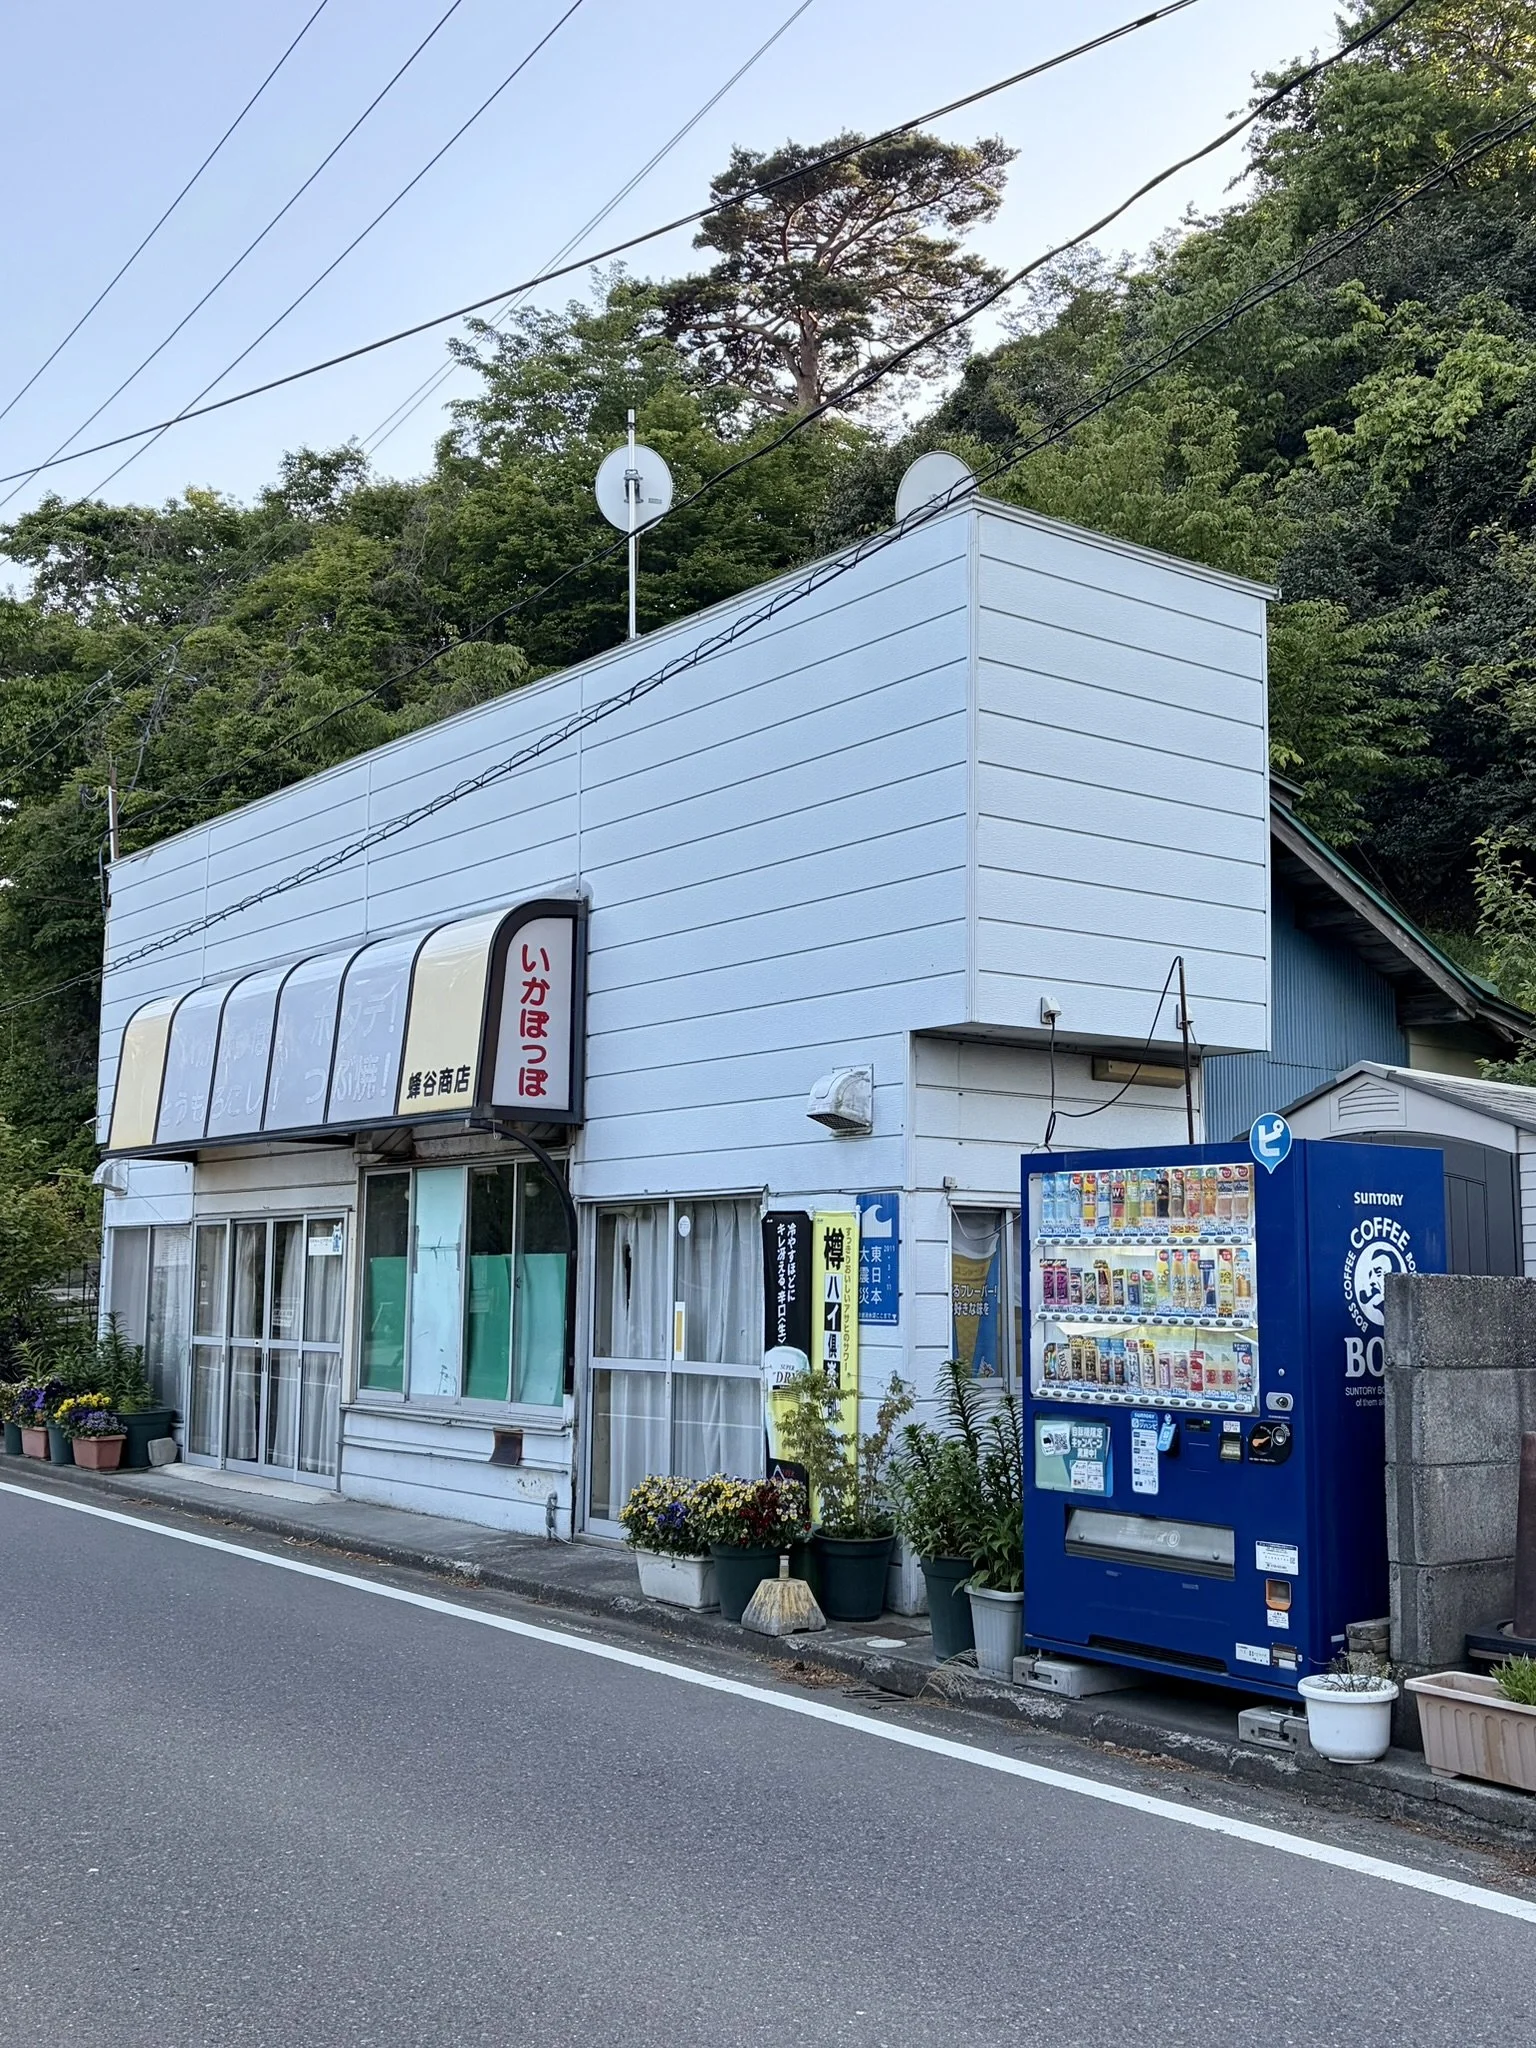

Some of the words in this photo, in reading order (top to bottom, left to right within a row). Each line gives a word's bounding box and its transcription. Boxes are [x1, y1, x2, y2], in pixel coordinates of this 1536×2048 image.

[519, 943, 551, 1097] いかぽっぽ
[406, 1064, 471, 1100] 蜂谷商店
[1353, 1191, 1404, 1207] SUNTORY
[1350, 1216, 1411, 1252] COFFEE
[870, 1245, 883, 1305] 東日本
[1343, 1250, 1357, 1300] COFFEE
[1405, 1252, 1417, 1274] BO
[1348, 1302, 1369, 1333] BOSS
[1344, 1337, 1385, 1378] BO
[1345, 1386, 1377, 1396] SUNTORY
